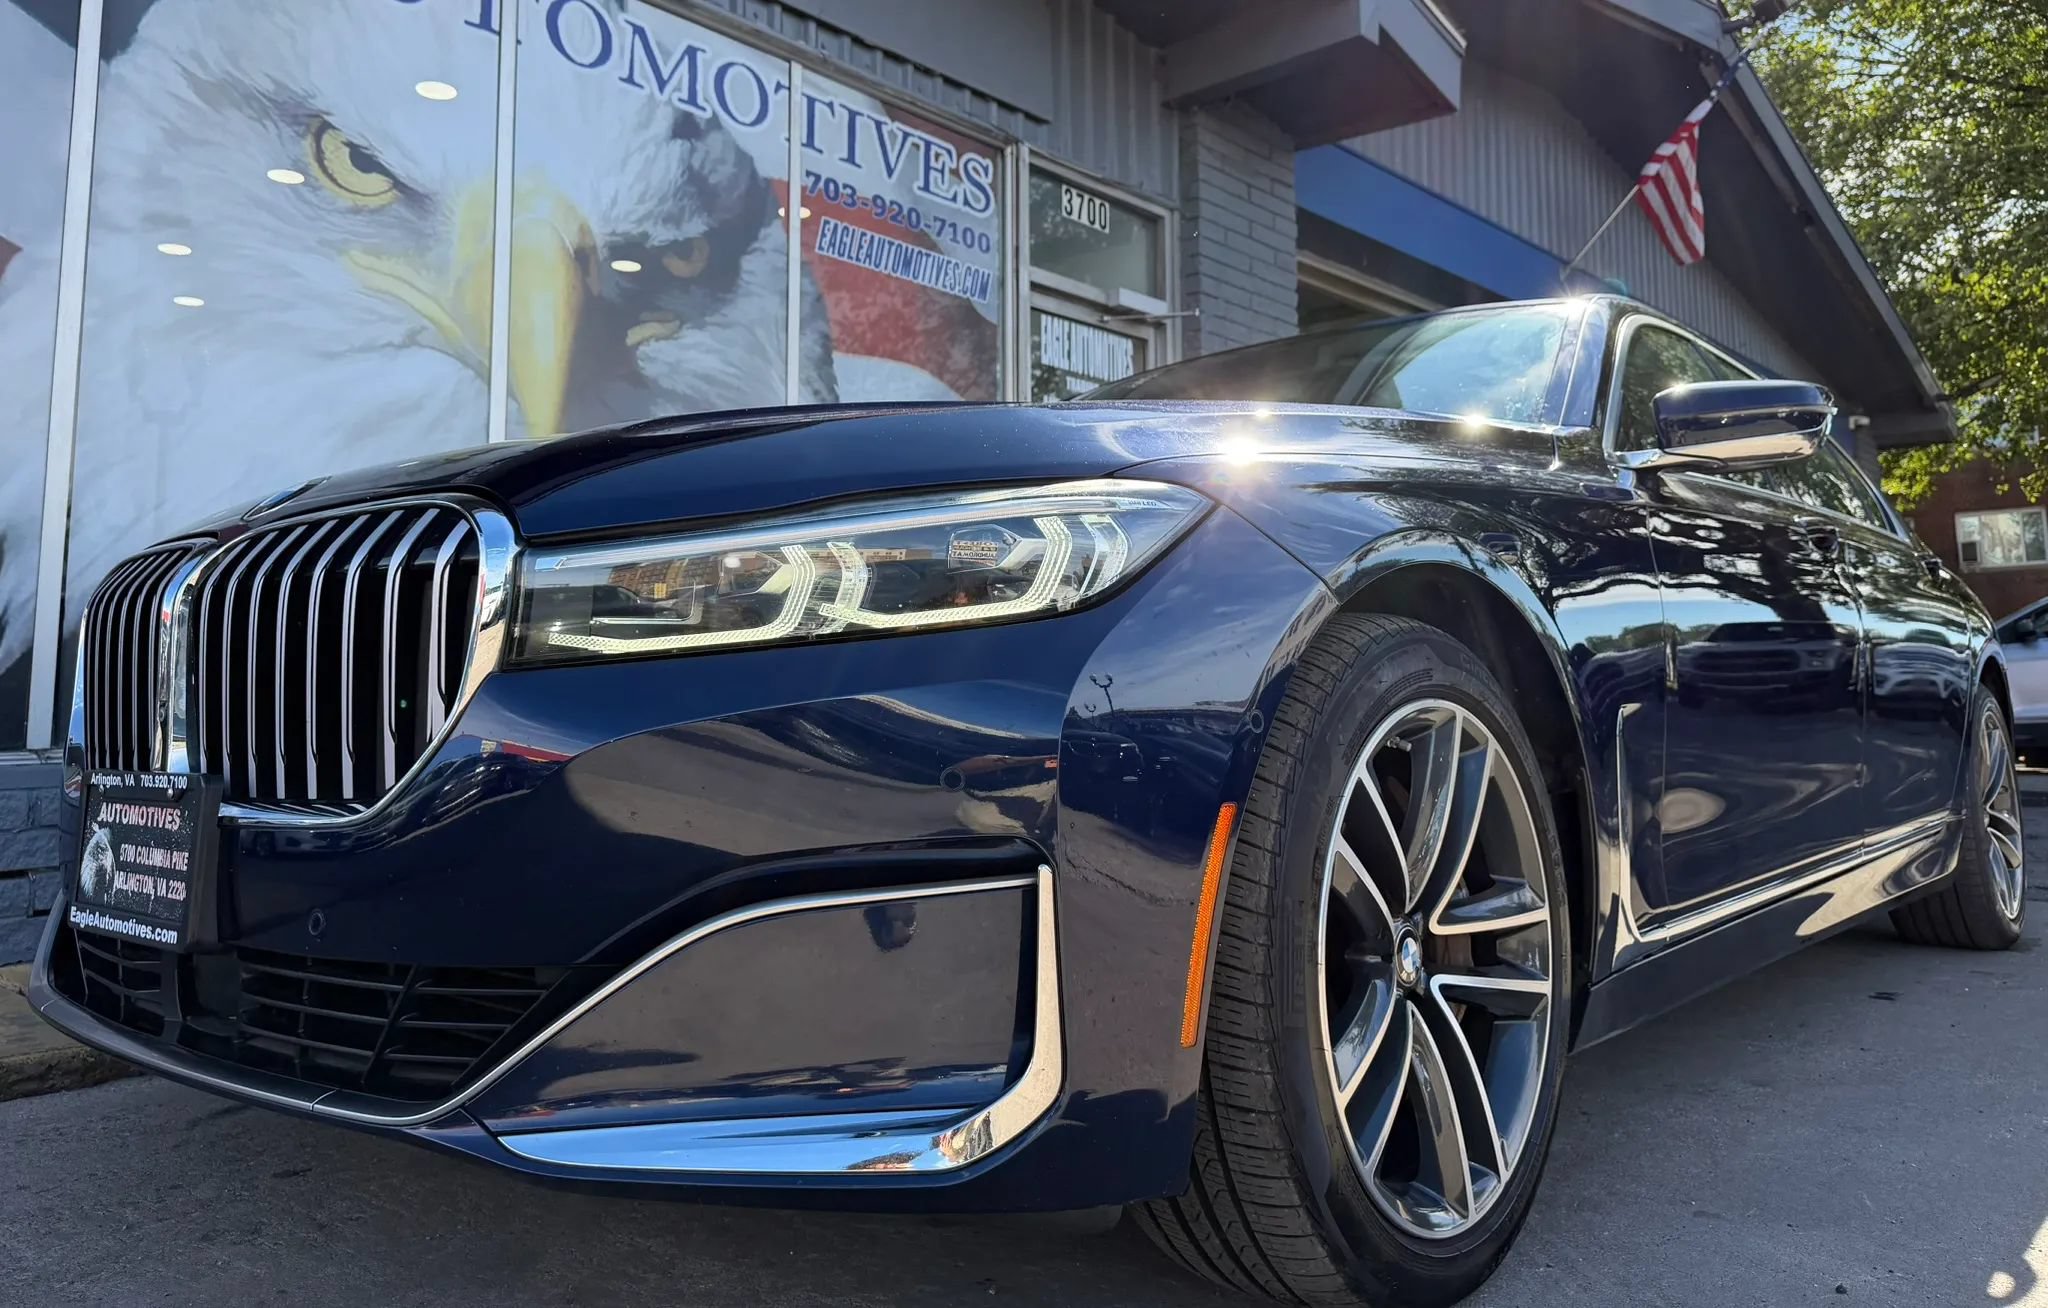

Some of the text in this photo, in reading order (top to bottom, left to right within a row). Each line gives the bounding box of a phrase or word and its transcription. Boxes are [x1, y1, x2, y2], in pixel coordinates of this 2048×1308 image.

[805, 169, 991, 254] 703-920-7100
[1063, 187, 1108, 231] 3700
[817, 219, 992, 301] EAGLEAUTOMOTIVES.COM
[90, 772, 187, 790] Arlington, VA 703.920.7100
[97, 802, 181, 831] AUTOMOTIVES
[136, 845, 171, 870] COLUMBIA
[171, 850, 190, 872] PIKE
[114, 870, 155, 898] ARLINGTON,
[157, 876, 167, 898] VA
[69, 905, 178, 945] EagleAutomotives.com
